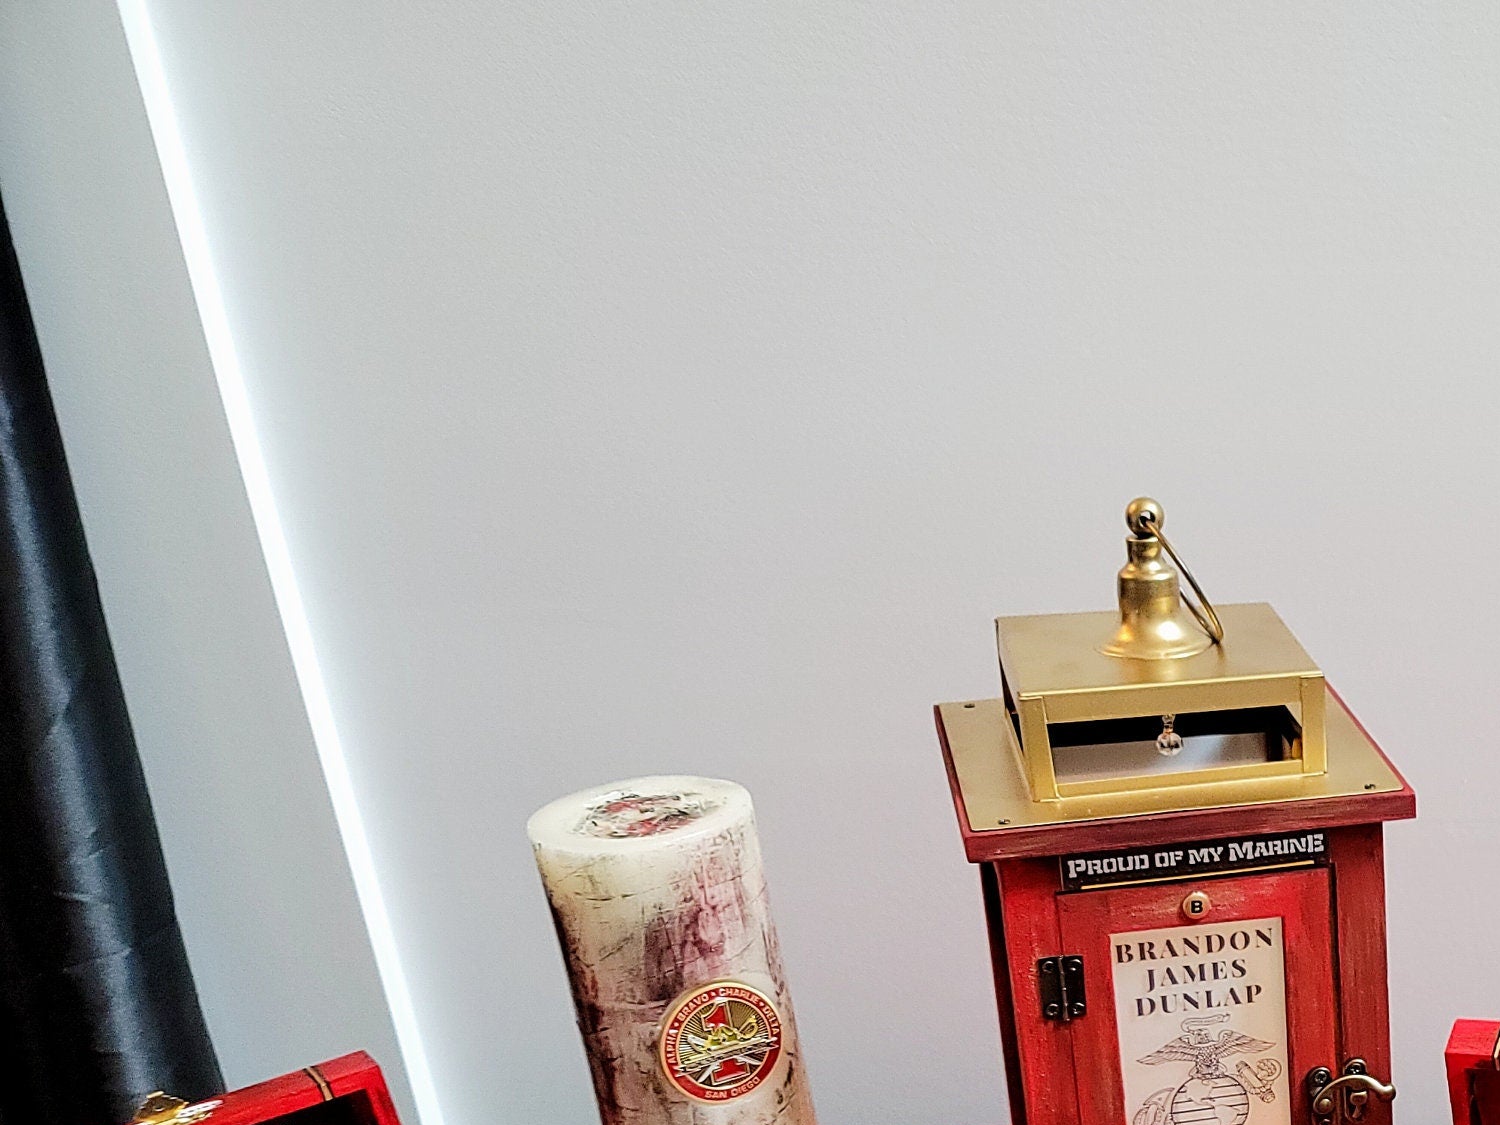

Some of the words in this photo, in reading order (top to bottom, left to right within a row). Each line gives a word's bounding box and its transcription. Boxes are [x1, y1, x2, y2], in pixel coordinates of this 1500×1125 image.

[1067, 853, 1149, 878] PROUD
[1154, 850, 1183, 868] OF
[1188, 846, 1223, 864] MY
[1228, 833, 1324, 860] MARINE
[1190, 900, 1204, 914] B
[1115, 927, 1273, 964] BRANDON
[1146, 958, 1247, 992] JAMES
[1135, 984, 1263, 1017] DUNLAP
[666, 1029, 678, 1064] ALPHA
[676, 993, 709, 1022] BRAVO
[718, 987, 761, 1005] CHARLIE
[761, 1005, 780, 1035] DELTA
[704, 1089, 728, 1099] SAN
[730, 1076, 761, 1098] DIEGO
